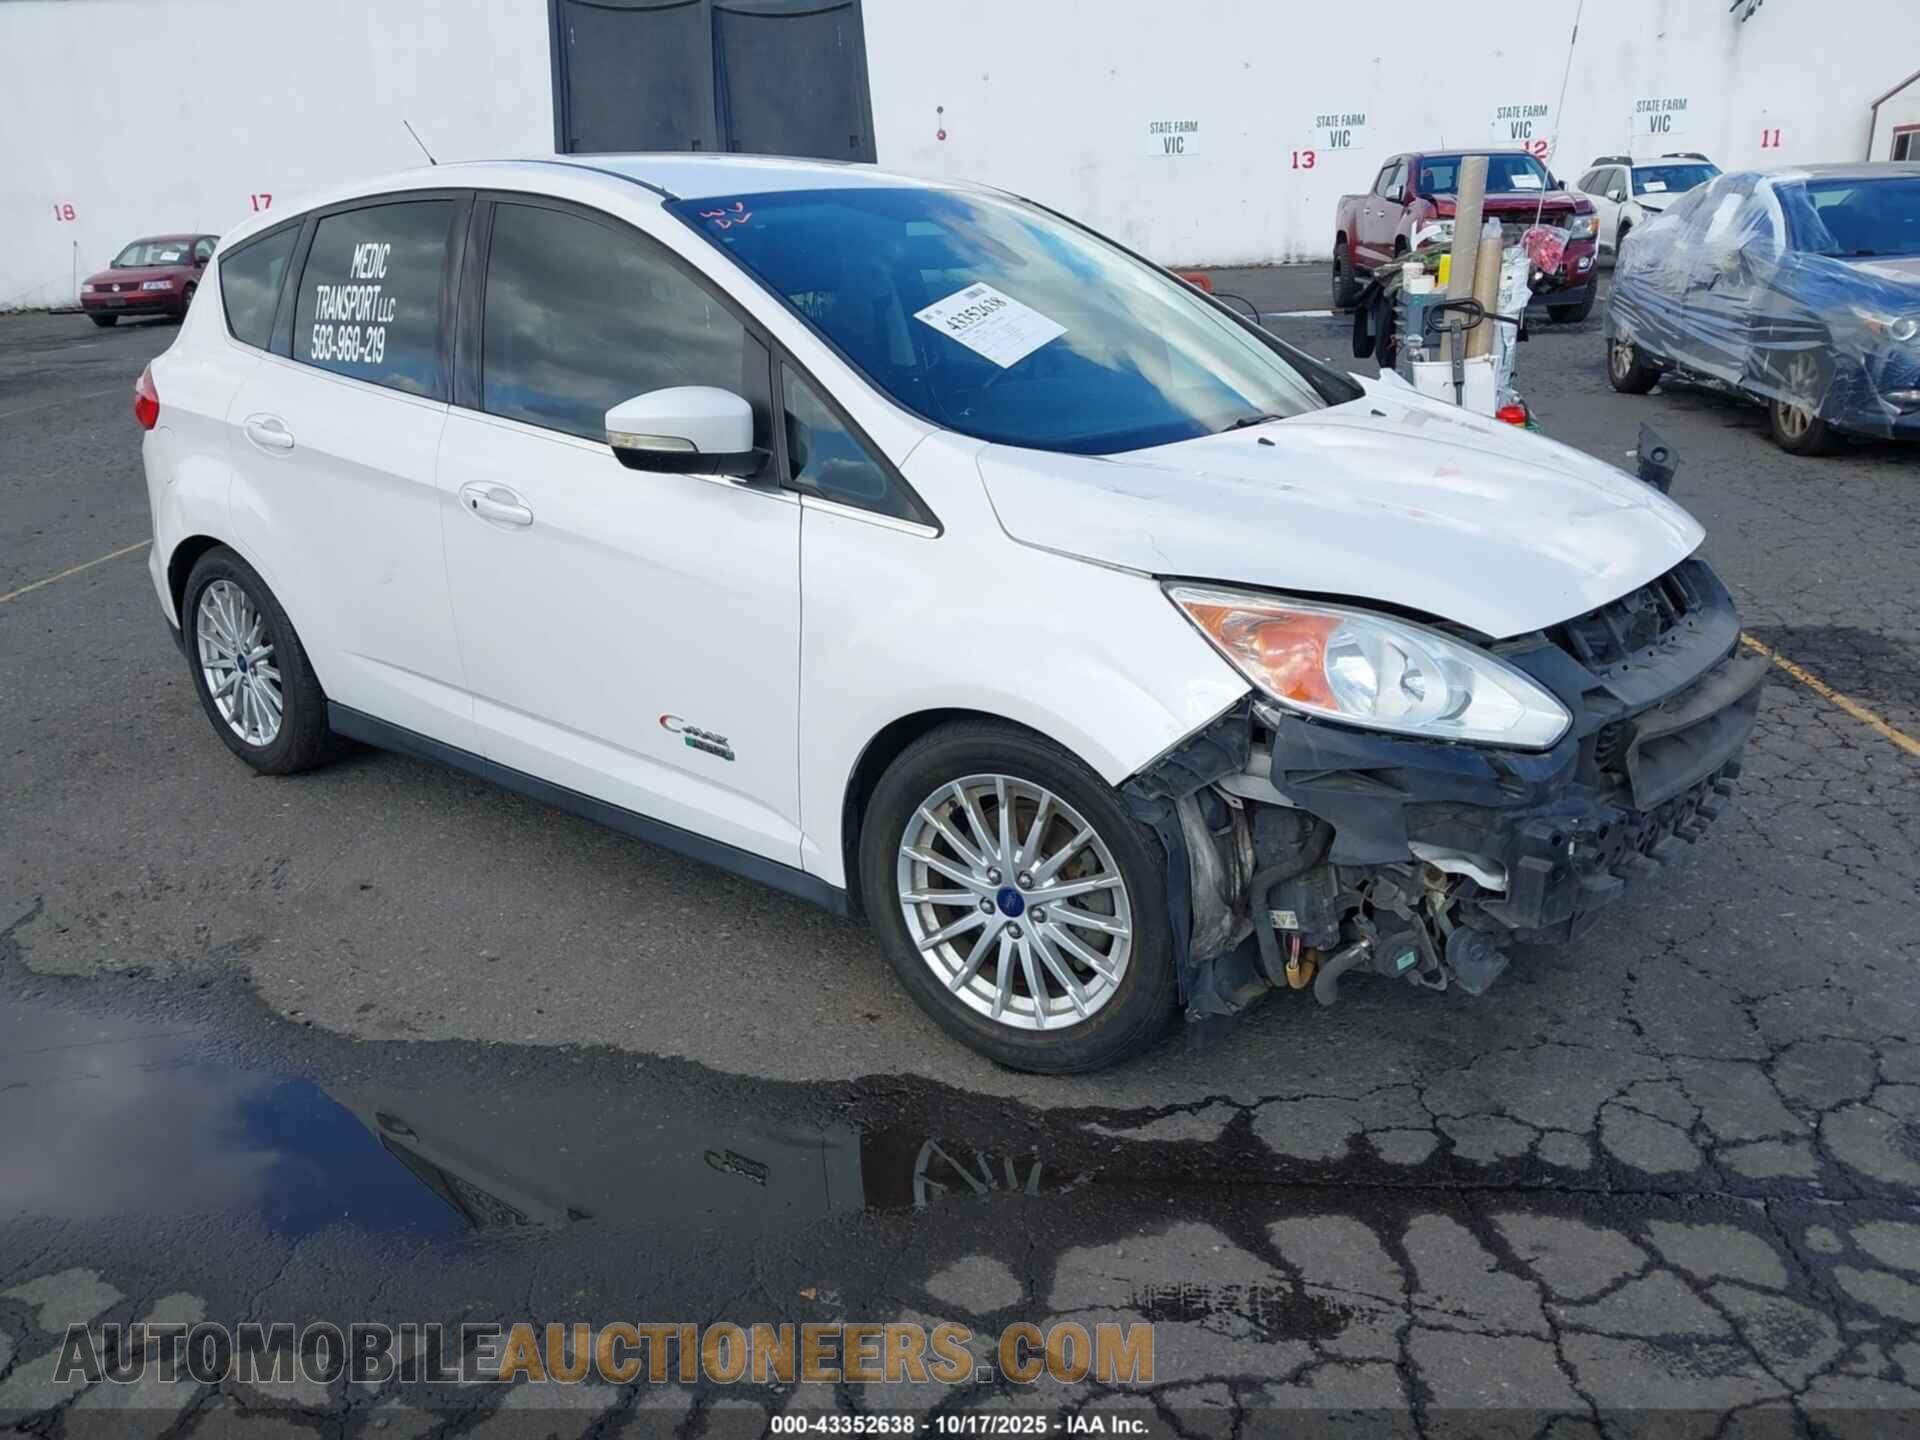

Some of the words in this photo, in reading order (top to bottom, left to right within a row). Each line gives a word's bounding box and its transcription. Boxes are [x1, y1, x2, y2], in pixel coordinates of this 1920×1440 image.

[1496, 106, 1521, 119] STATE
[1522, 104, 1548, 117] FARM
[1636, 100, 1660, 113] STATE
[1661, 98, 1687, 111] FARM
[1150, 121, 1173, 134] STATE
[1174, 120, 1199, 133] FARM
[1316, 115, 1341, 128] STATE
[1341, 113, 1366, 127] FARM
[1650, 114, 1672, 133] VIC
[1330, 129, 1351, 148] VIC
[1510, 121, 1532, 140] VIC
[1761, 129, 1781, 148] 11
[1163, 136, 1185, 154] VIC
[1291, 151, 1316, 169] 13
[251, 194, 272, 212] 17
[53, 204, 76, 221] 18
[350, 243, 391, 279] MEDIC
[315, 285, 382, 321] TRANSPORT
[377, 297, 397, 322] LLC
[945, 296, 1008, 331] 43352638
